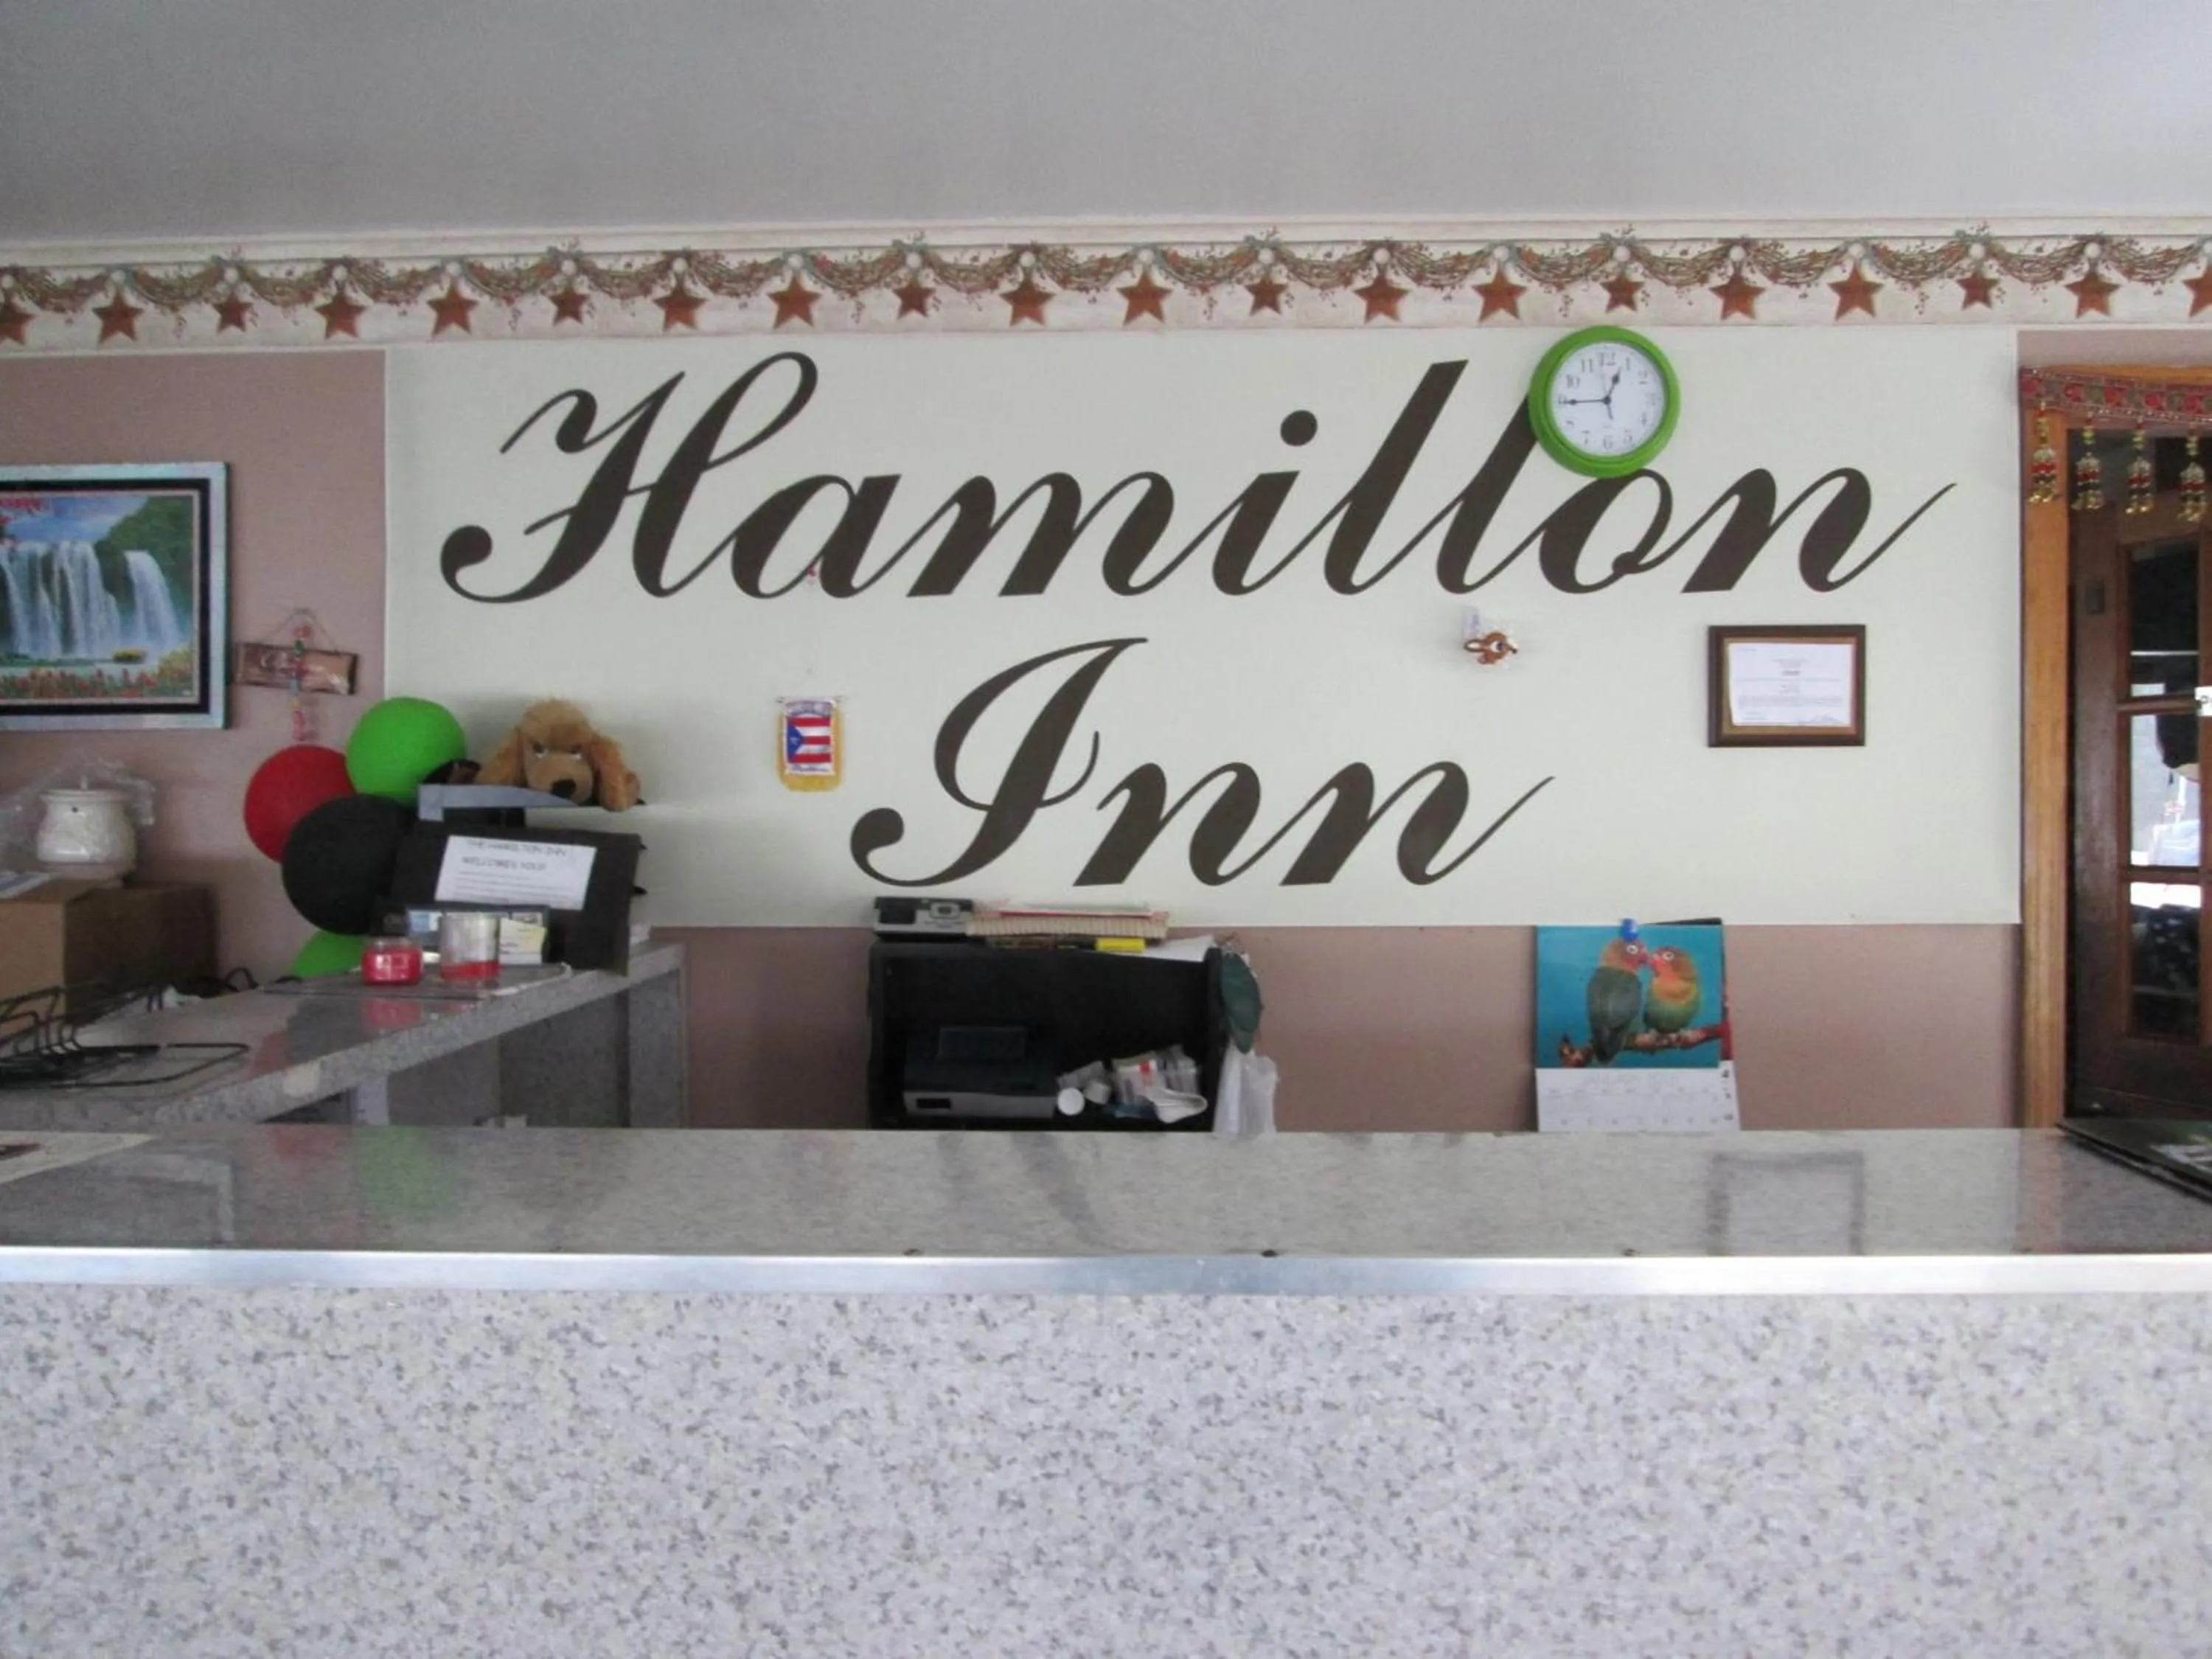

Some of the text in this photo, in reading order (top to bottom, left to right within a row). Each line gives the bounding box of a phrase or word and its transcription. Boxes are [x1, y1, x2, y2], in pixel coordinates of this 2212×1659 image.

[1581, 358, 1593, 372] 11
[1596, 352, 1617, 366] 12
[1565, 374, 1581, 389] 10
[849, 637, 1555, 888] Inn
